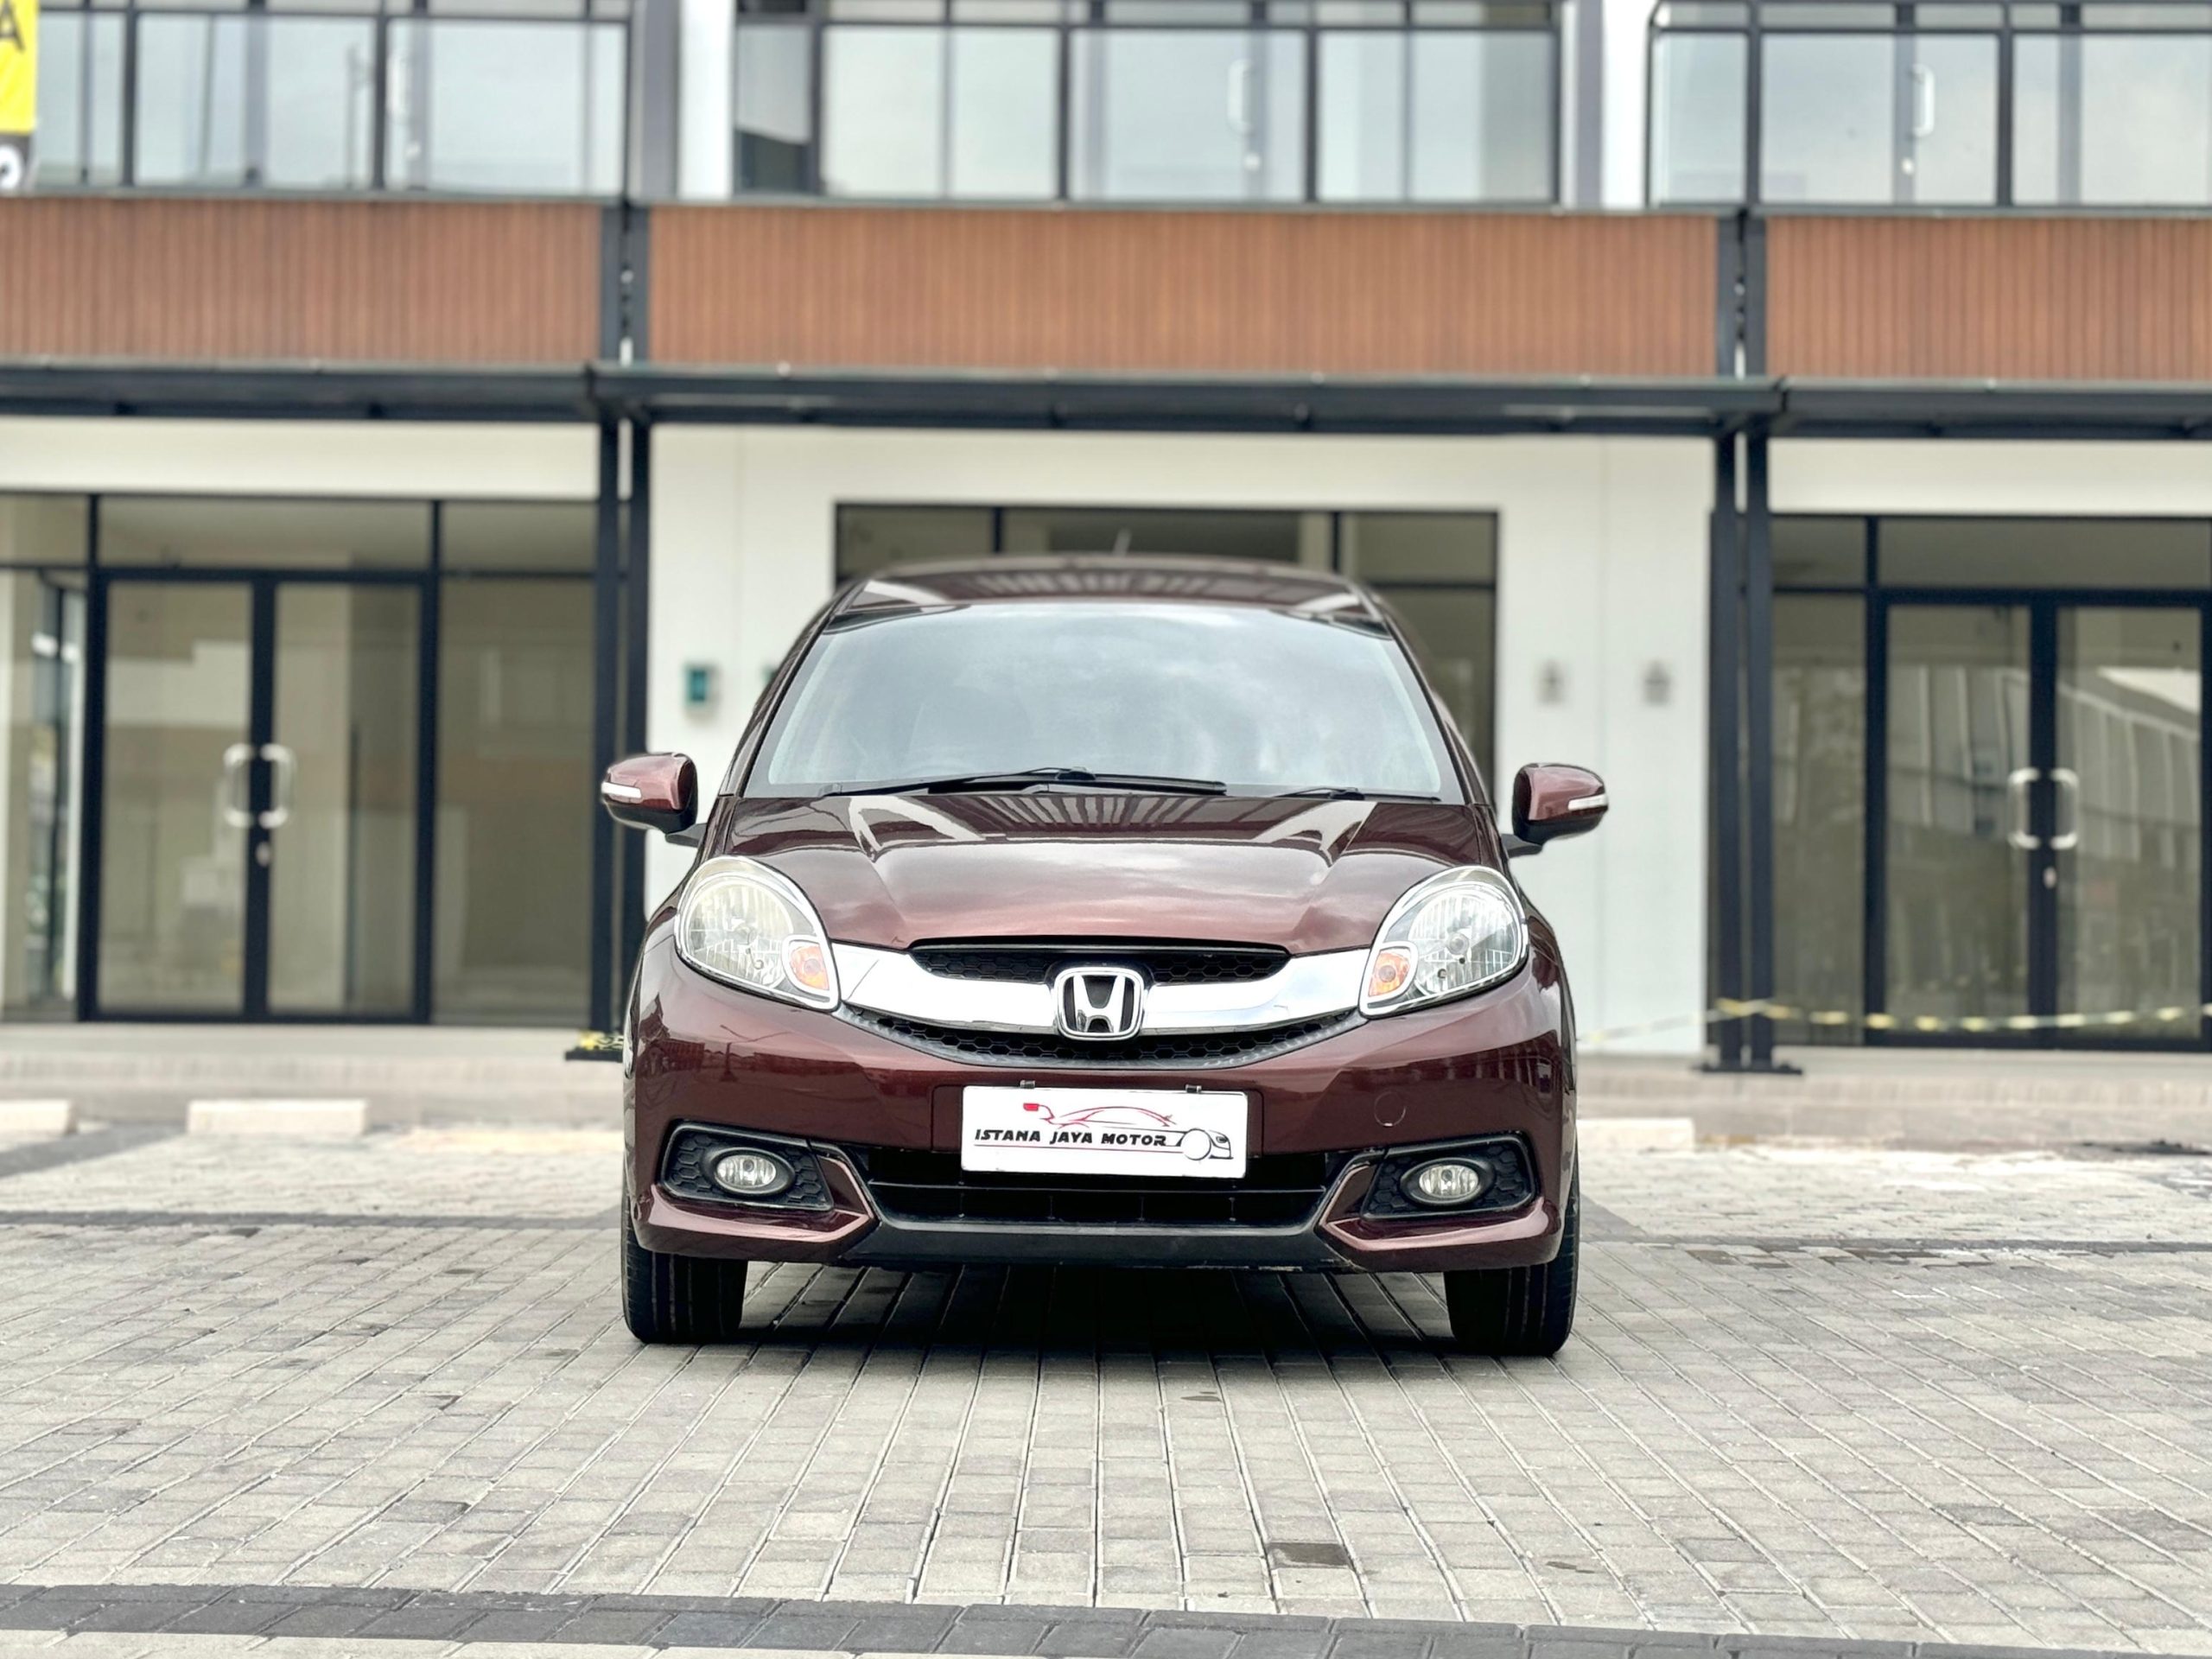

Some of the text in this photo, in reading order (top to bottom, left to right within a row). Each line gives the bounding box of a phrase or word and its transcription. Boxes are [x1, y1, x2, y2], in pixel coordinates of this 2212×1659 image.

[975, 1128, 1166, 1147] ISTANA JAYA MOTOR
